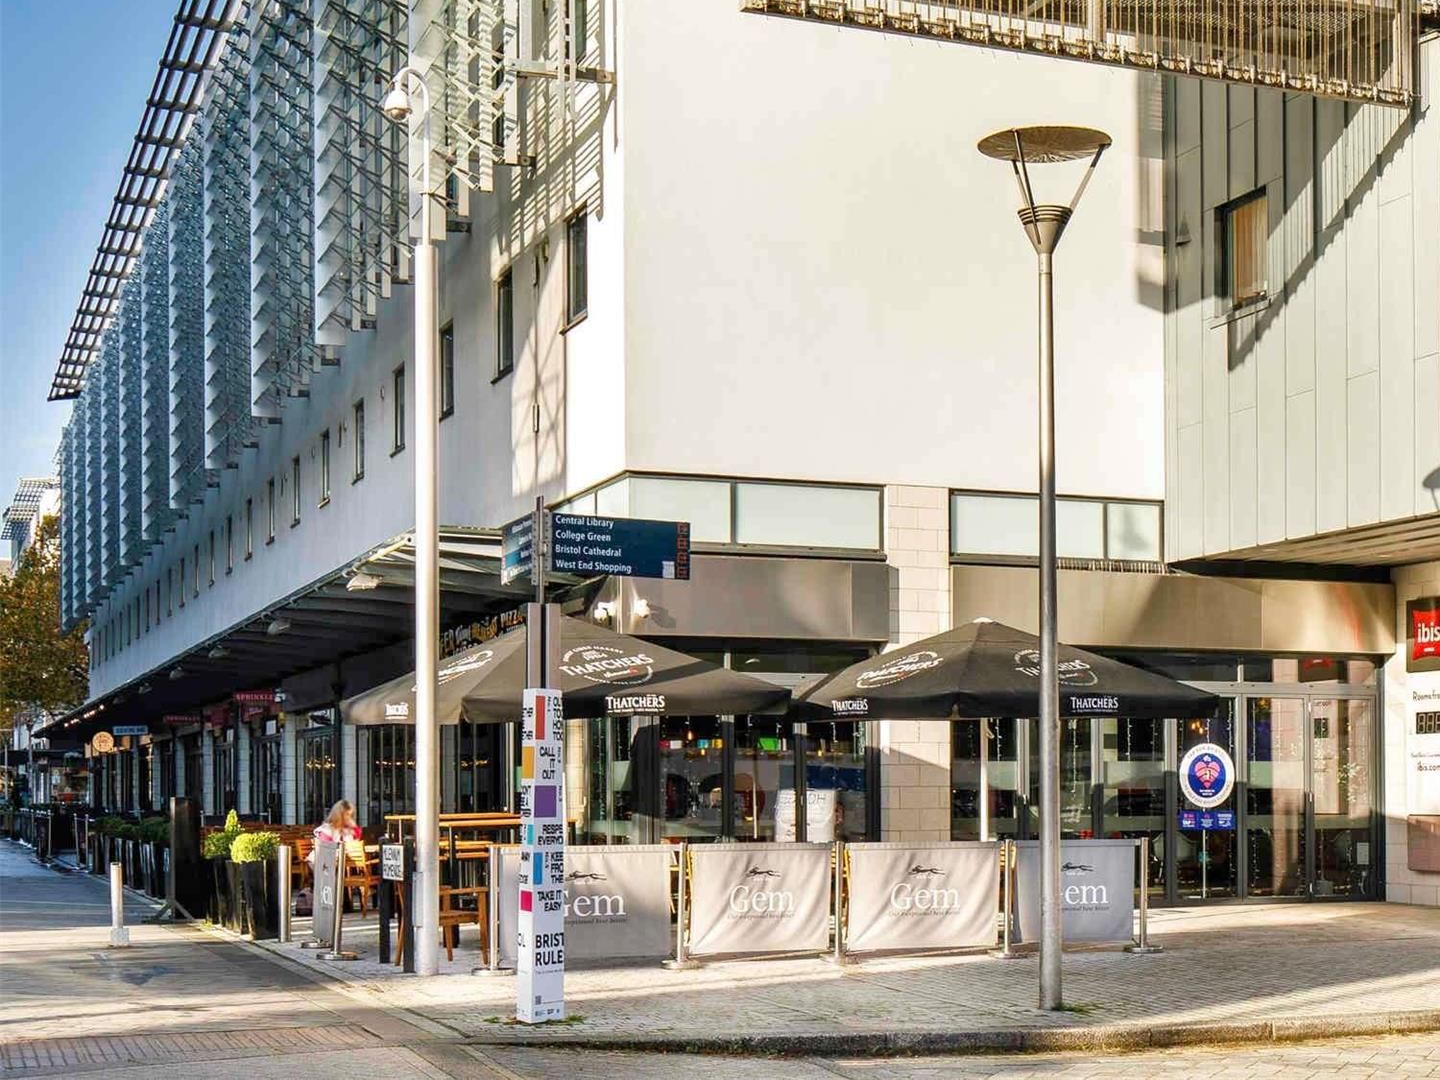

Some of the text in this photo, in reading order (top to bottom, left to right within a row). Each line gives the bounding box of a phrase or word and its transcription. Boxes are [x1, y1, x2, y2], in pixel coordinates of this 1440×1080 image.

[555, 514, 614, 530] Central Library
[555, 529, 612, 542] College Green
[555, 545, 622, 557] Bristol Cathedral
[555, 559, 632, 574] West End Shopping
[559, 653, 655, 677] THATCHERS
[605, 695, 666, 709] THATCHERS
[832, 698, 869, 711] THATCHERS
[1070, 696, 1119, 709] THATCHERS
[540, 746, 556, 758] CALL
[542, 769, 556, 780] OUT
[542, 824, 563, 835] RESPE
[537, 836, 564, 846] EVERYO
[551, 851, 564, 862] KEE
[551, 863, 564, 873] FRO
[537, 889, 563, 902] TAKE IT
[730, 884, 794, 913] Gem
[890, 881, 961, 911] Gem
[1060, 883, 1108, 905] em
[544, 901, 562, 912] EASY
[535, 932, 565, 949] BRIST
[535, 950, 564, 967] RULE
